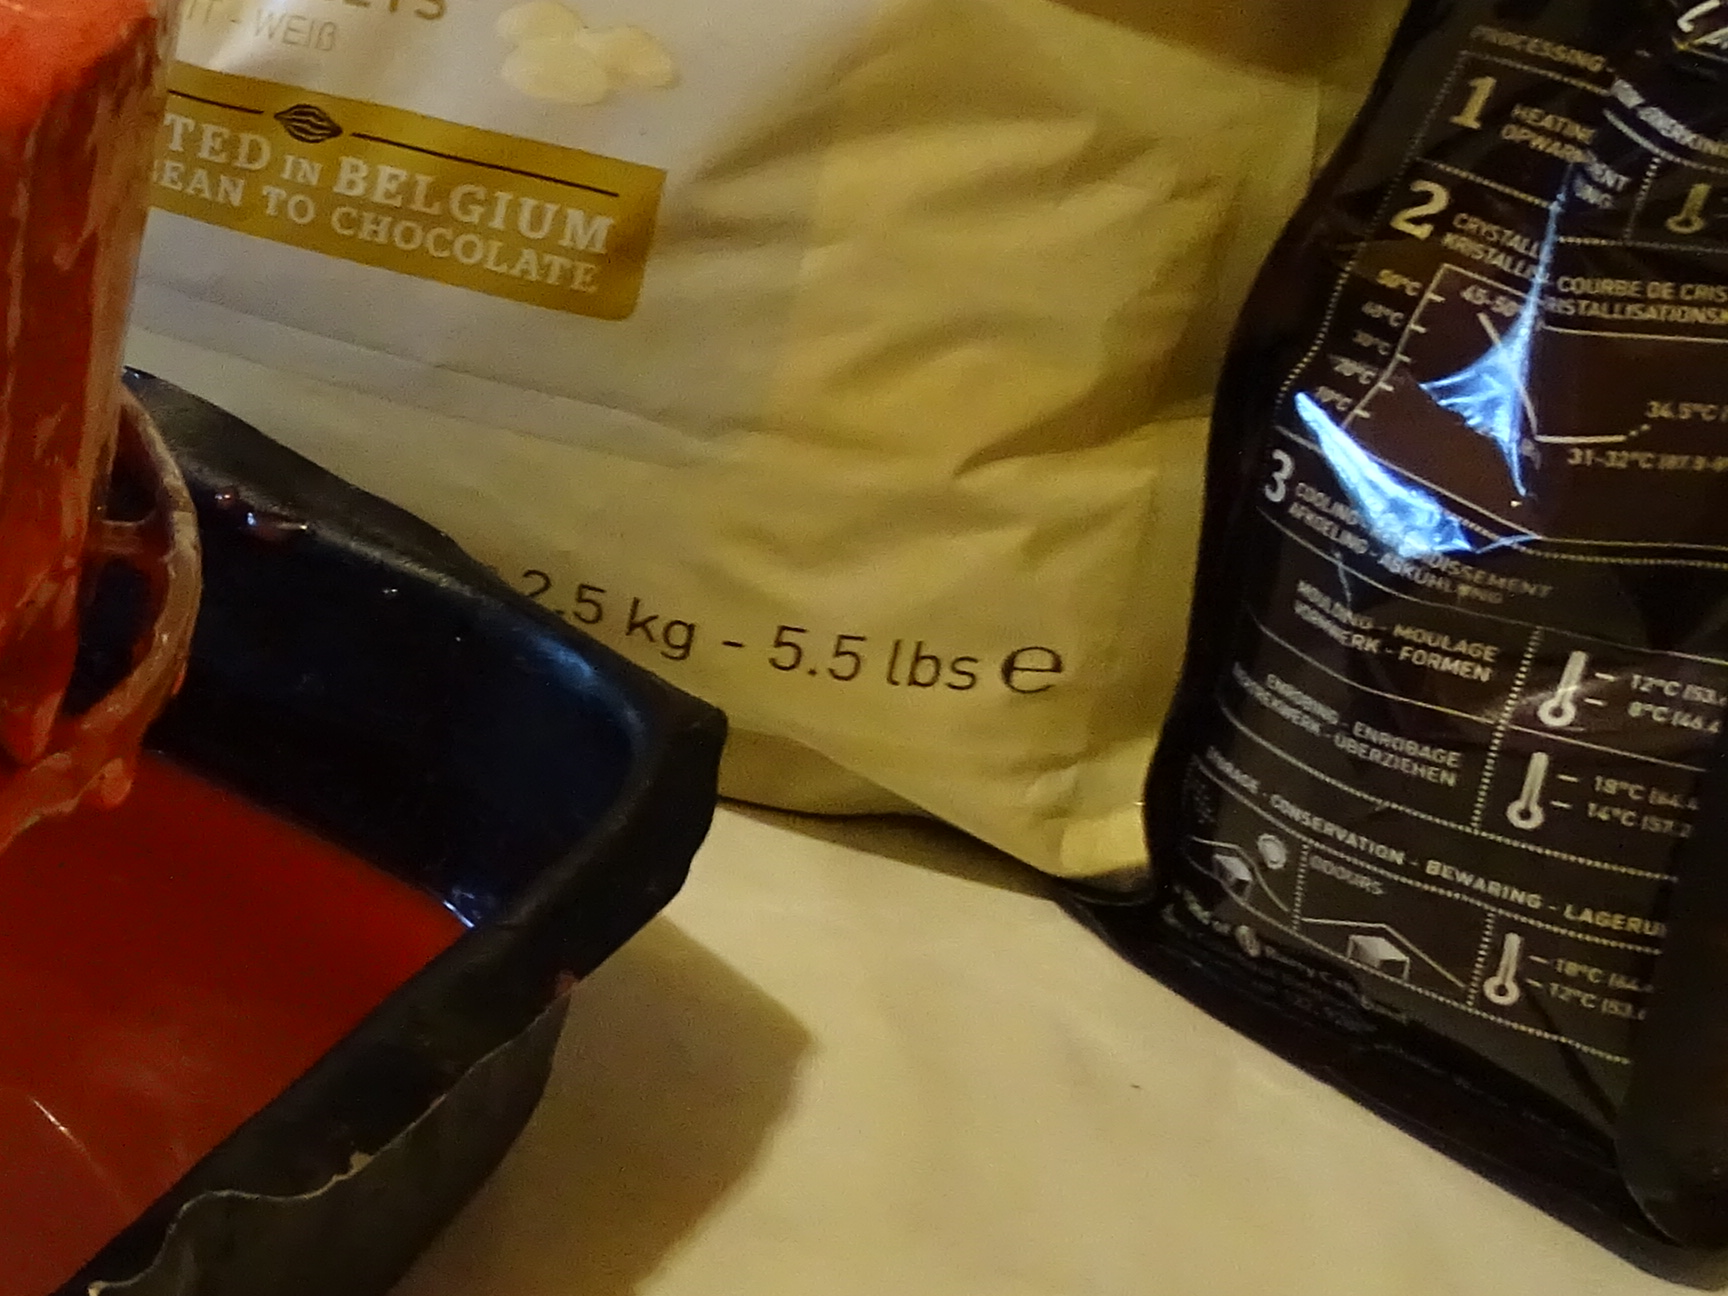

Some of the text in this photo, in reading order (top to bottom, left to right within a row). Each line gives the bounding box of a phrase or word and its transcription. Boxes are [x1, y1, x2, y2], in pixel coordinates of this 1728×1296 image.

[1449, 75, 1497, 130] 1
[281, 154, 323, 187] IN
[332, 155, 616, 255] BELGIUM
[1389, 180, 1452, 240] 2
[262, 186, 316, 225] TO
[331, 206, 600, 294] CHOCOLATE
[1556, 275, 1644, 297] COURBE
[1680, 284, 1728, 303] CRIS
[1264, 448, 1293, 502] 3
[625, 596, 697, 661] kg
[767, 624, 868, 682] 5.5
[885, 638, 979, 691] lbs
[1394, 623, 1499, 663] MOULAGE
[1398, 645, 1494, 683] FORMEN
[1352, 721, 1463, 770] ENROBAGE
[1425, 858, 1543, 910] BEWARING
